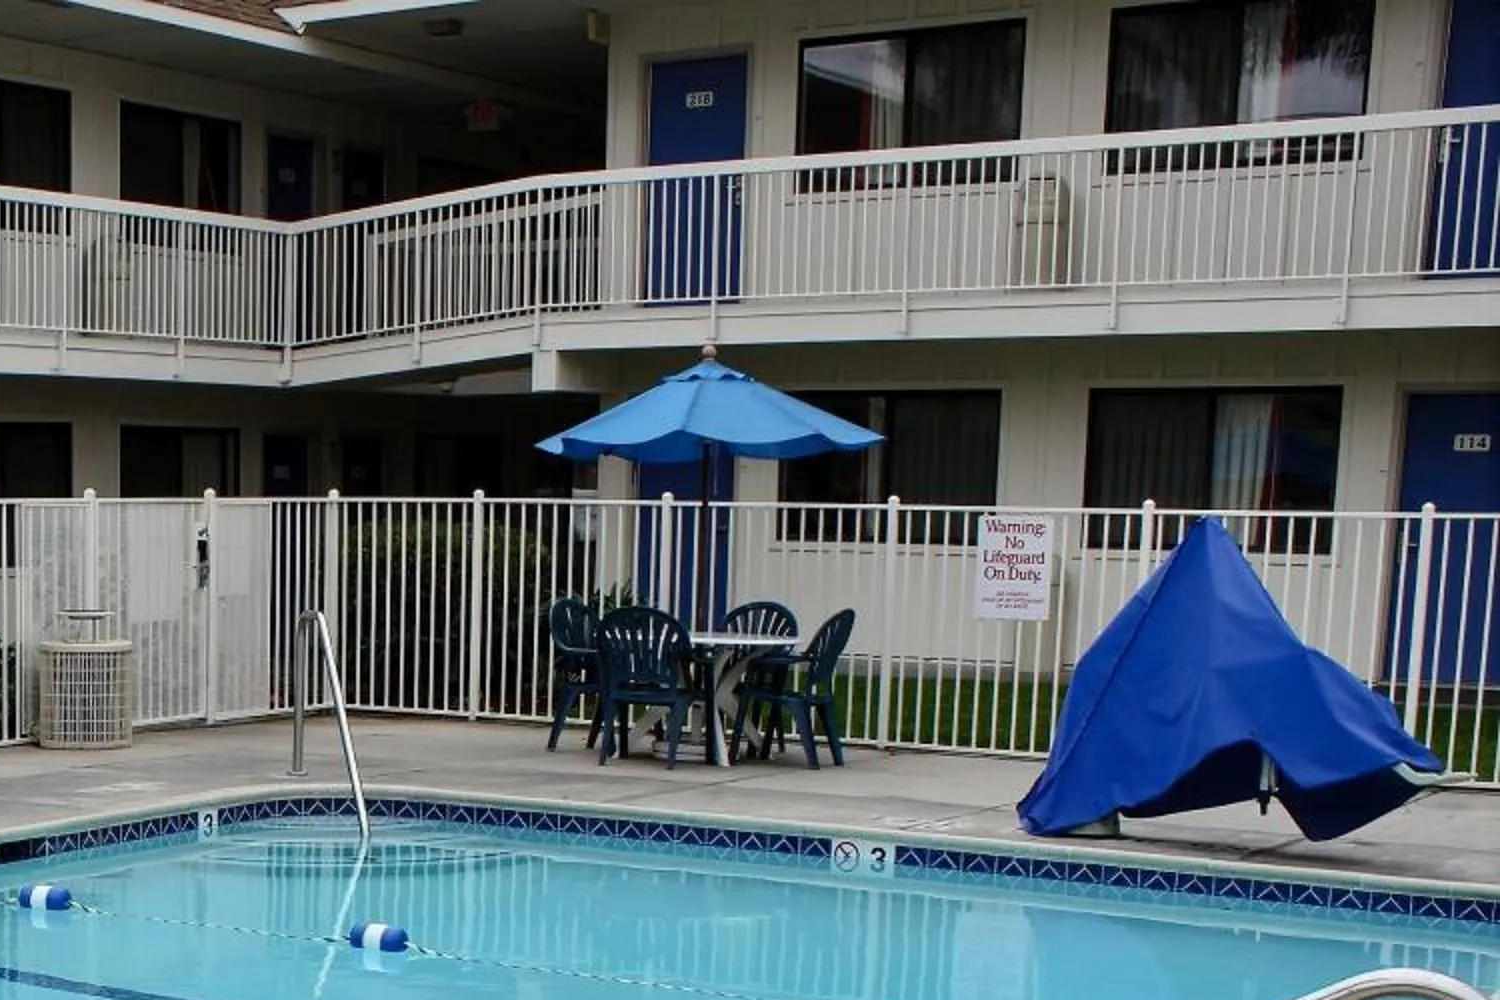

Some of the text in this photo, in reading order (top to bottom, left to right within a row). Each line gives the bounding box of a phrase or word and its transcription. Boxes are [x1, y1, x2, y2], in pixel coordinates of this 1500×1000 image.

[1459, 437, 1486, 449] 114
[1004, 535, 1026, 549] No
[983, 549, 1045, 567] Lifeguard
[983, 565, 1005, 581] On
